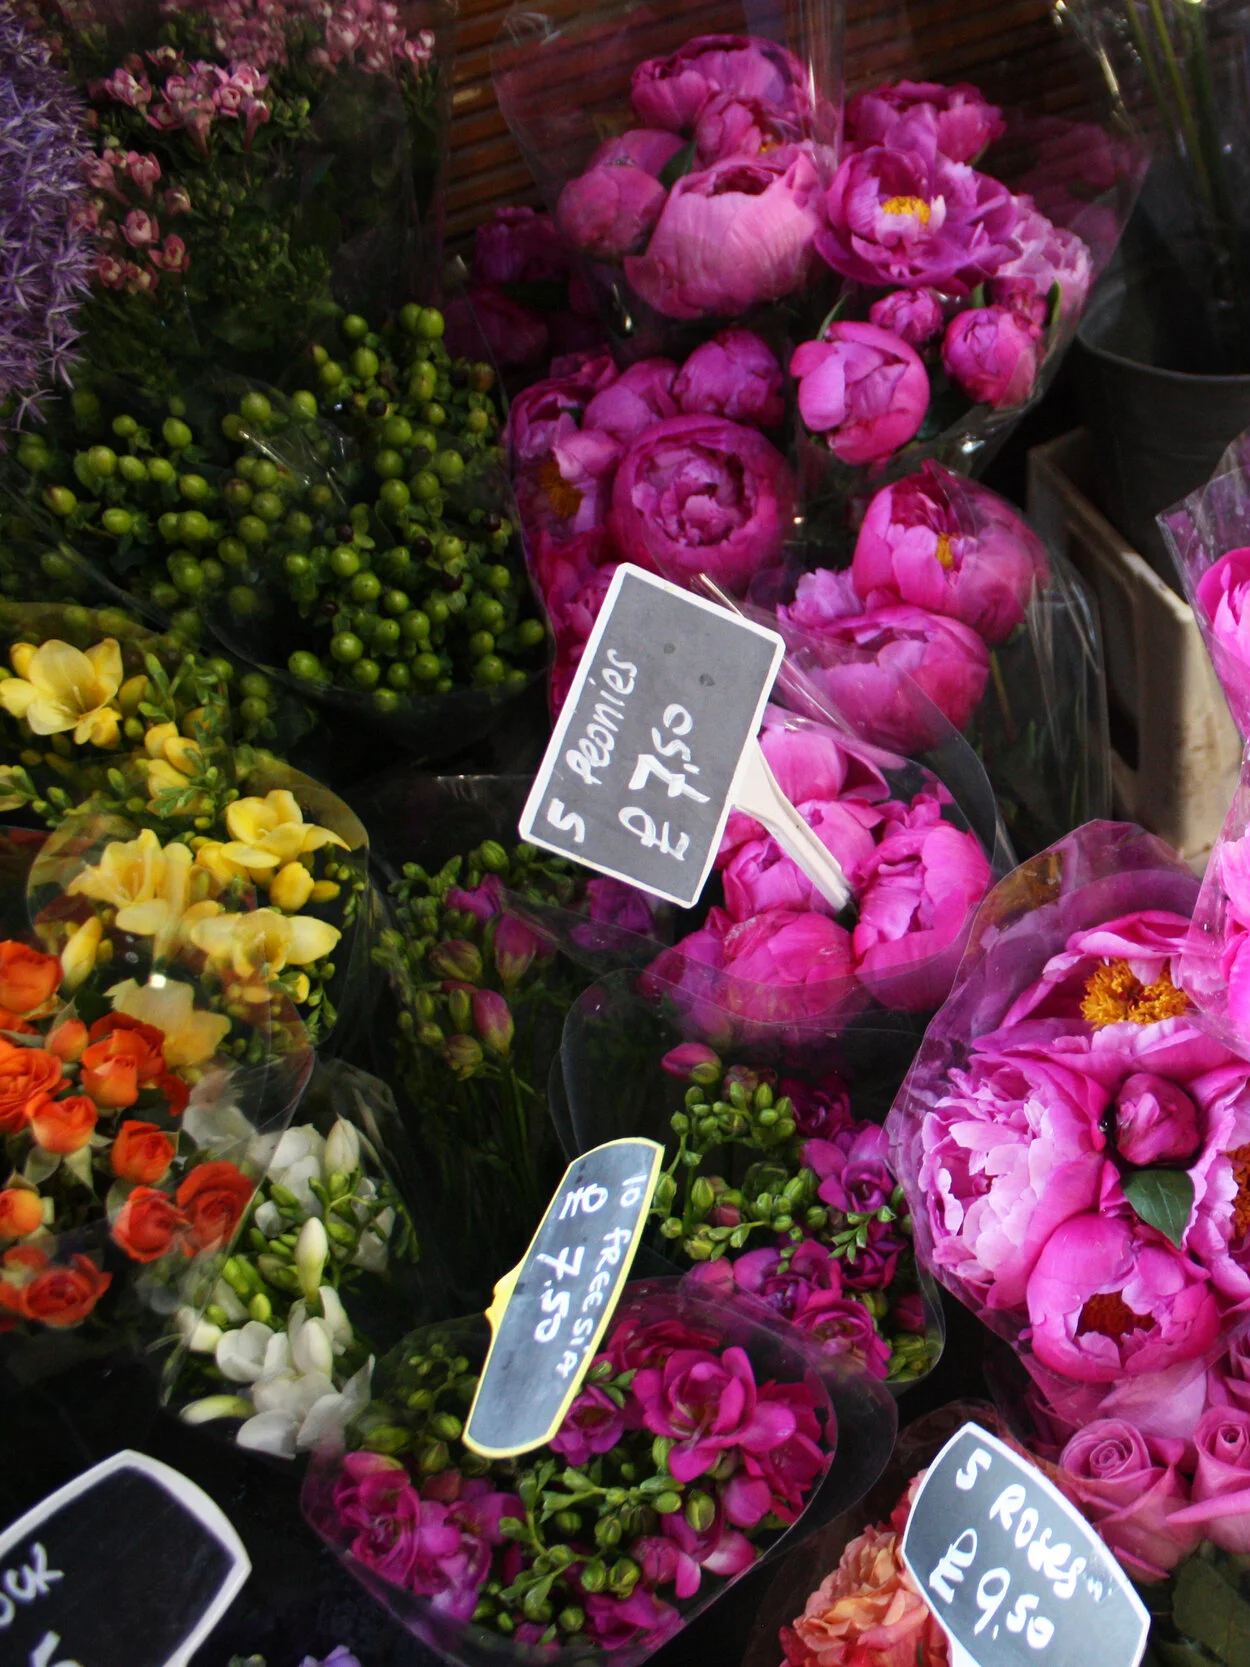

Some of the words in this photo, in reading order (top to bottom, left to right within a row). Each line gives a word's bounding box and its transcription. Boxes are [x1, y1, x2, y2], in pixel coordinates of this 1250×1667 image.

[565, 648, 638, 785] Peonies
[546, 798, 585, 843] 5
[619, 1174, 648, 1209] 10
[955, 1448, 992, 1490] 5
